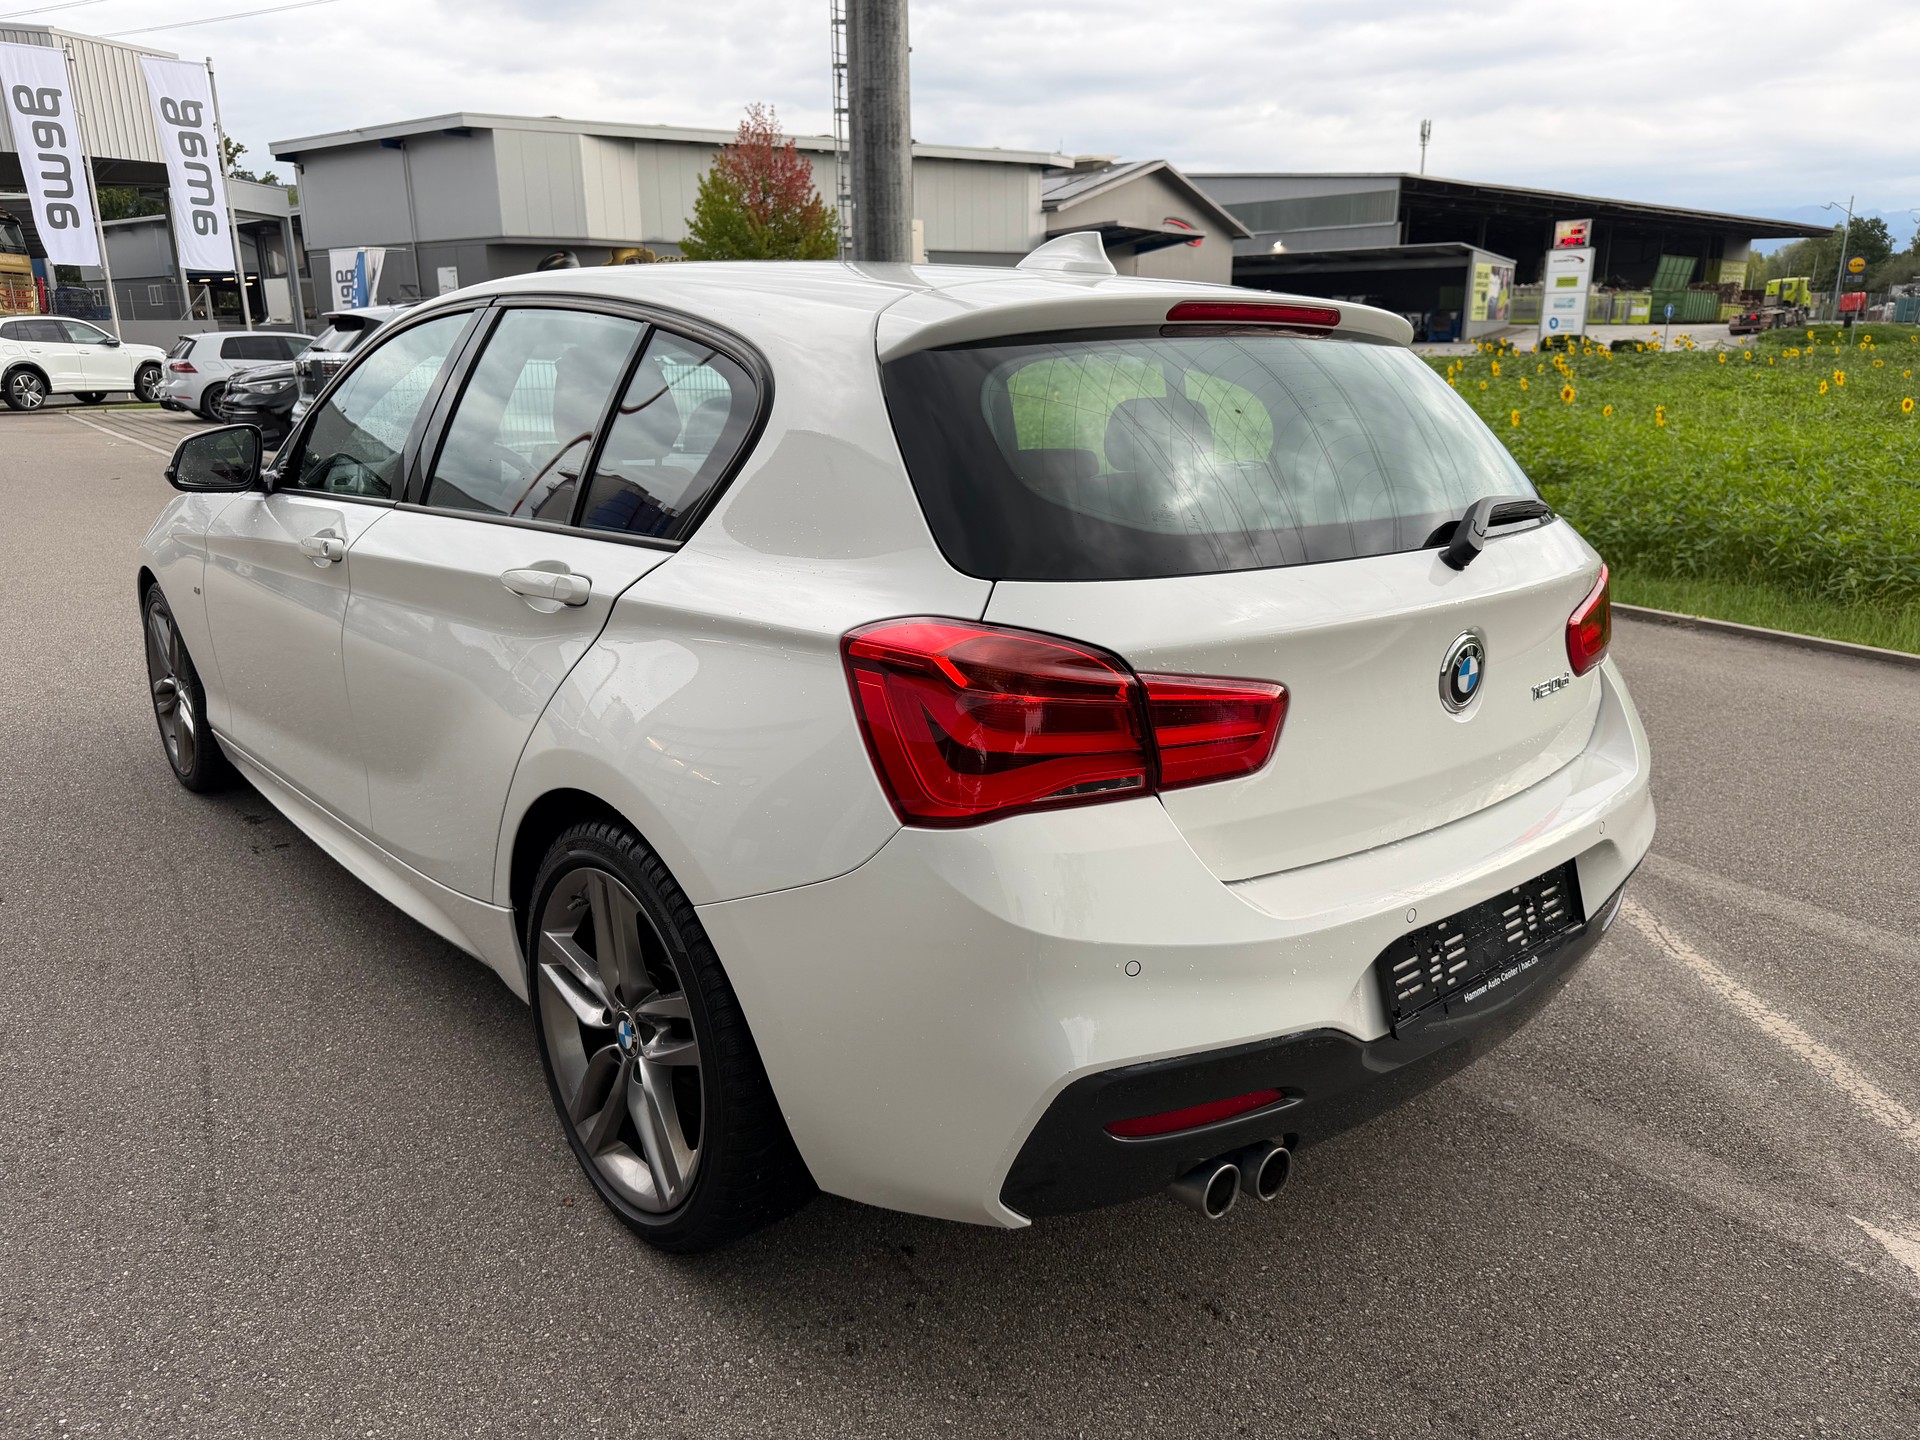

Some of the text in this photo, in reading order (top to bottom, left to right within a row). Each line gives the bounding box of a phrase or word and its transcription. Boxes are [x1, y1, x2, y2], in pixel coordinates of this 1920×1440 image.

[1455, 645, 1482, 668] BMW
[1464, 985, 1488, 1002] Hammer
[1488, 977, 1500, 989] Auto
[1500, 967, 1518, 981] Center
[1521, 955, 1538, 970] hac.ch
